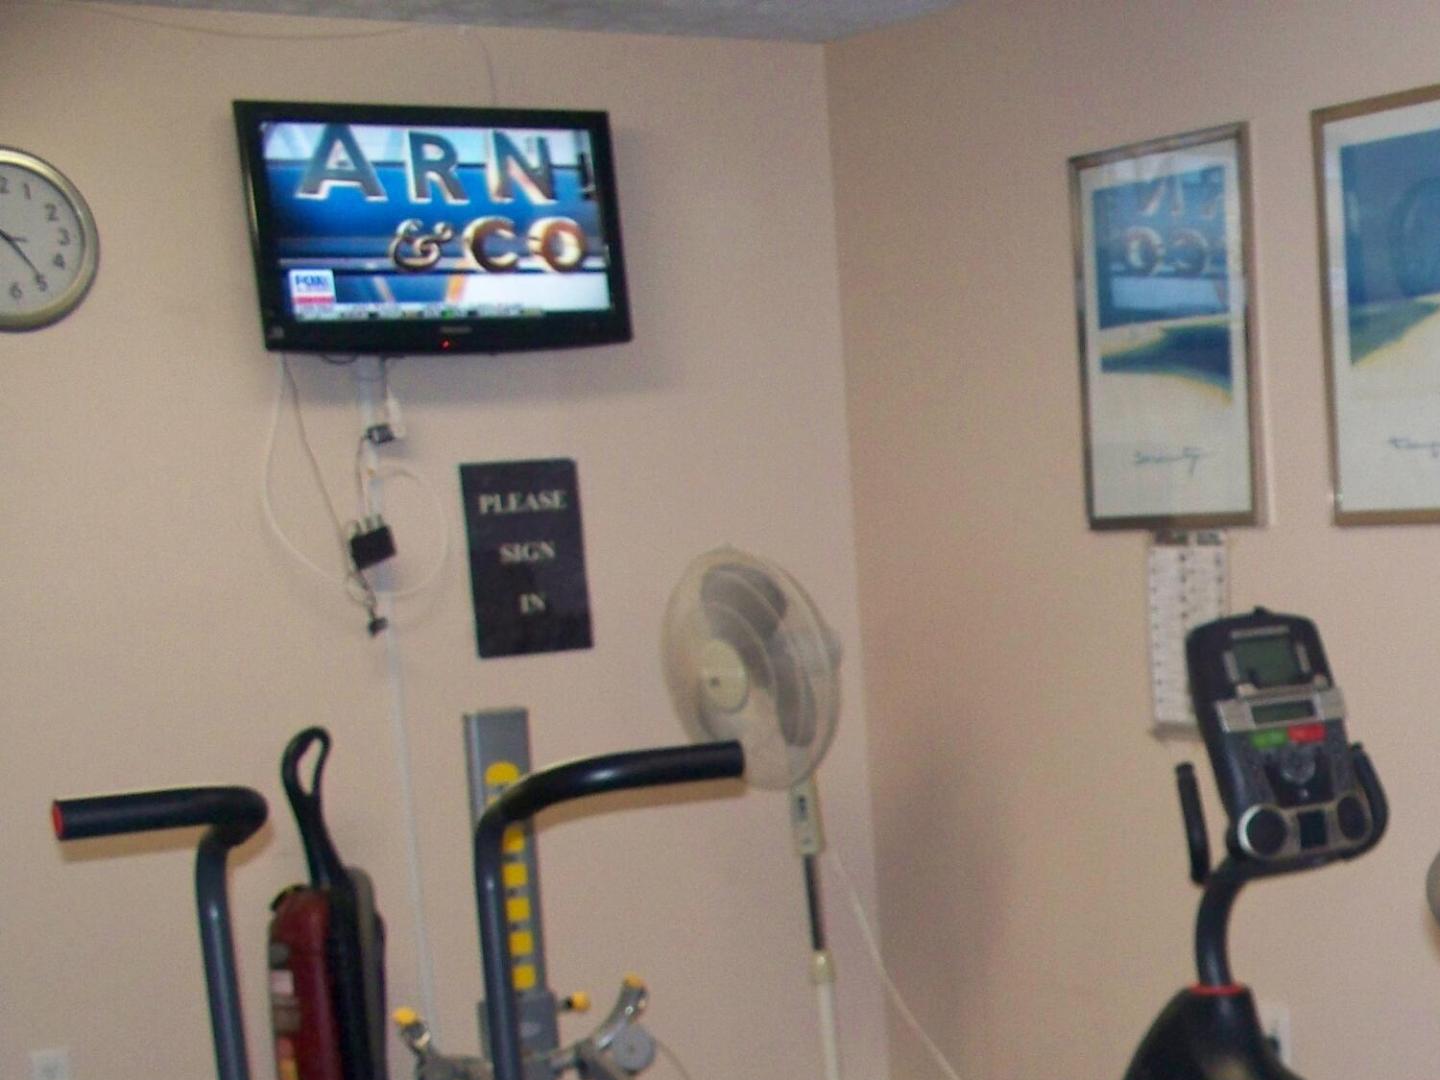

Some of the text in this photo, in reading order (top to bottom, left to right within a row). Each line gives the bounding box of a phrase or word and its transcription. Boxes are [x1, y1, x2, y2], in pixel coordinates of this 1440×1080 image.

[45, 202, 59, 221] 2
[478, 489, 569, 516] PLEASE
[499, 540, 557, 565] SIGN
[518, 592, 547, 615] IN
